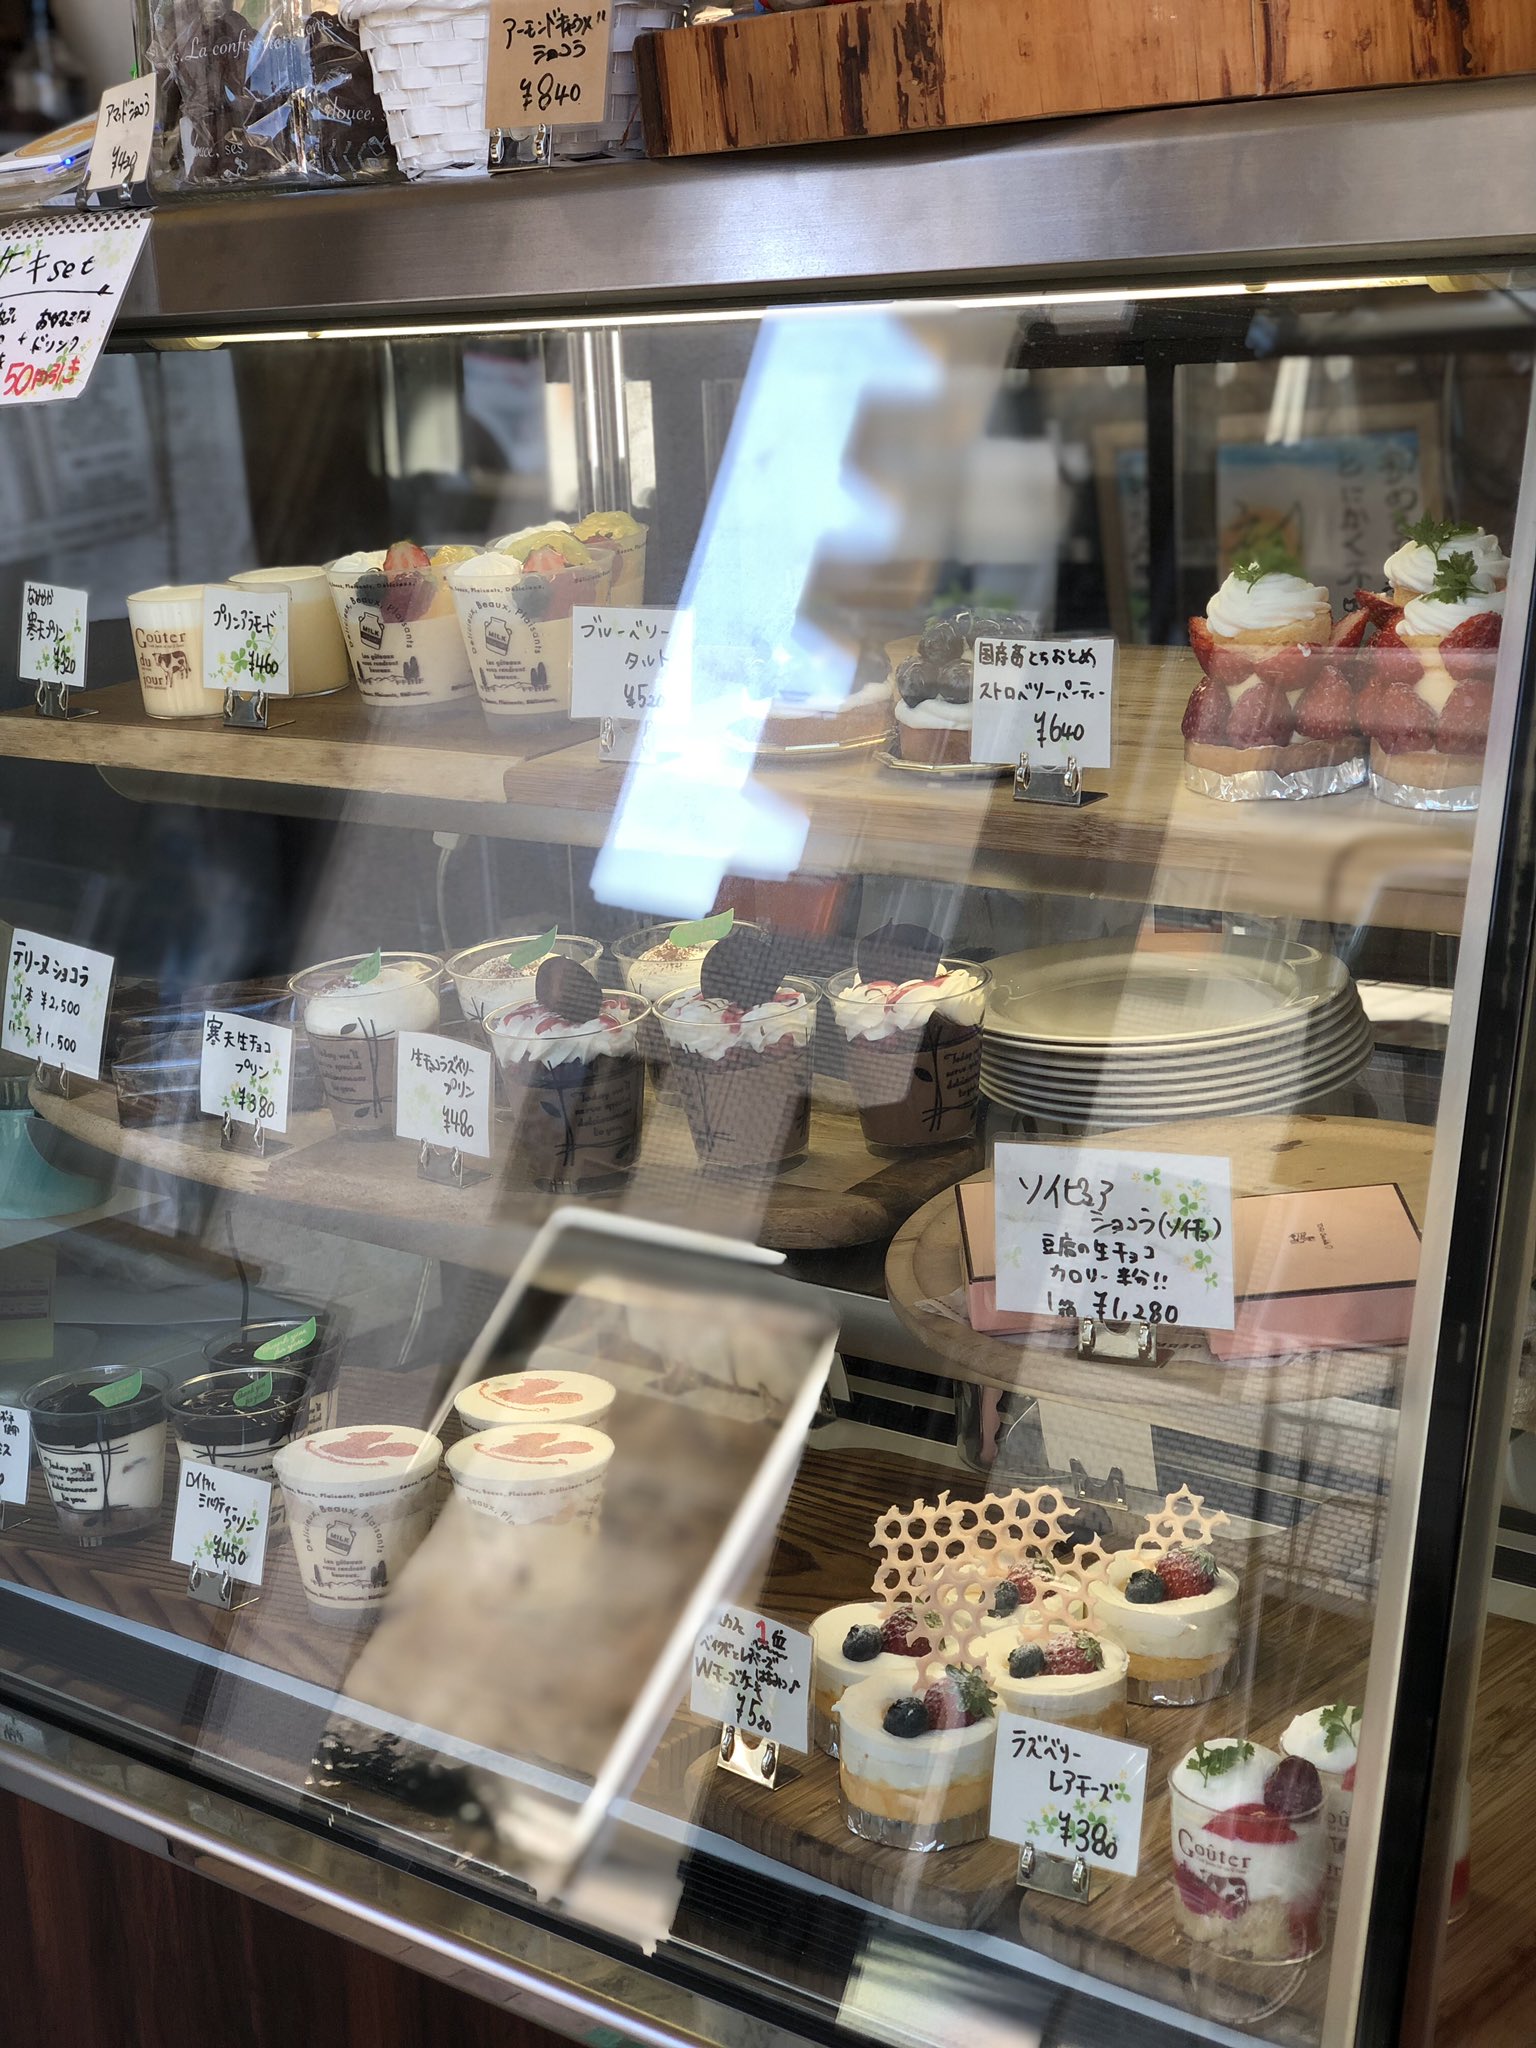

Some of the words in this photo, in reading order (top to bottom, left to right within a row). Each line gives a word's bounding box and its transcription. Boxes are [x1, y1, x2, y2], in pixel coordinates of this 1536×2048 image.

[519, 72, 581, 111] ¥840
[30, 334, 80, 355] ドリンク
[26, 608, 66, 643] 寒天プリン
[135, 627, 186, 649] Goûter
[580, 614, 670, 640] ブルーベリー
[53, 646, 76, 675] ¥320
[139, 652, 151, 668] du
[248, 650, 279, 677] ¥460
[624, 648, 669, 670] タルト
[979, 679, 1105, 702] ストロベリーパーティー
[1034, 711, 1085, 748] ¥640
[13, 941, 89, 988] テリーヌショコラ
[40, 990, 80, 1017] ¥2,500
[36, 1024, 77, 1053] ¥1,500
[205, 1014, 272, 1054] 寒天生チョコ
[235, 1058, 270, 1080] プリン
[238, 1086, 276, 1119] ¥380
[443, 1077, 475, 1098] プリン
[442, 1105, 474, 1138] ¥480
[1042, 1232, 1155, 1264] 豆腐の生チョコ
[1093, 1290, 1179, 1324] ¥1,280
[223, 1514, 255, 1534] プリン
[212, 1534, 247, 1568] ¥450
[736, 1692, 772, 1733] ¥520
[1011, 1729, 1082, 1764] ラズベリー
[1049, 1769, 1119, 1804] レアチーズ
[1058, 1810, 1119, 1860] ¥380
[1178, 1827, 1252, 1869] Goûter
